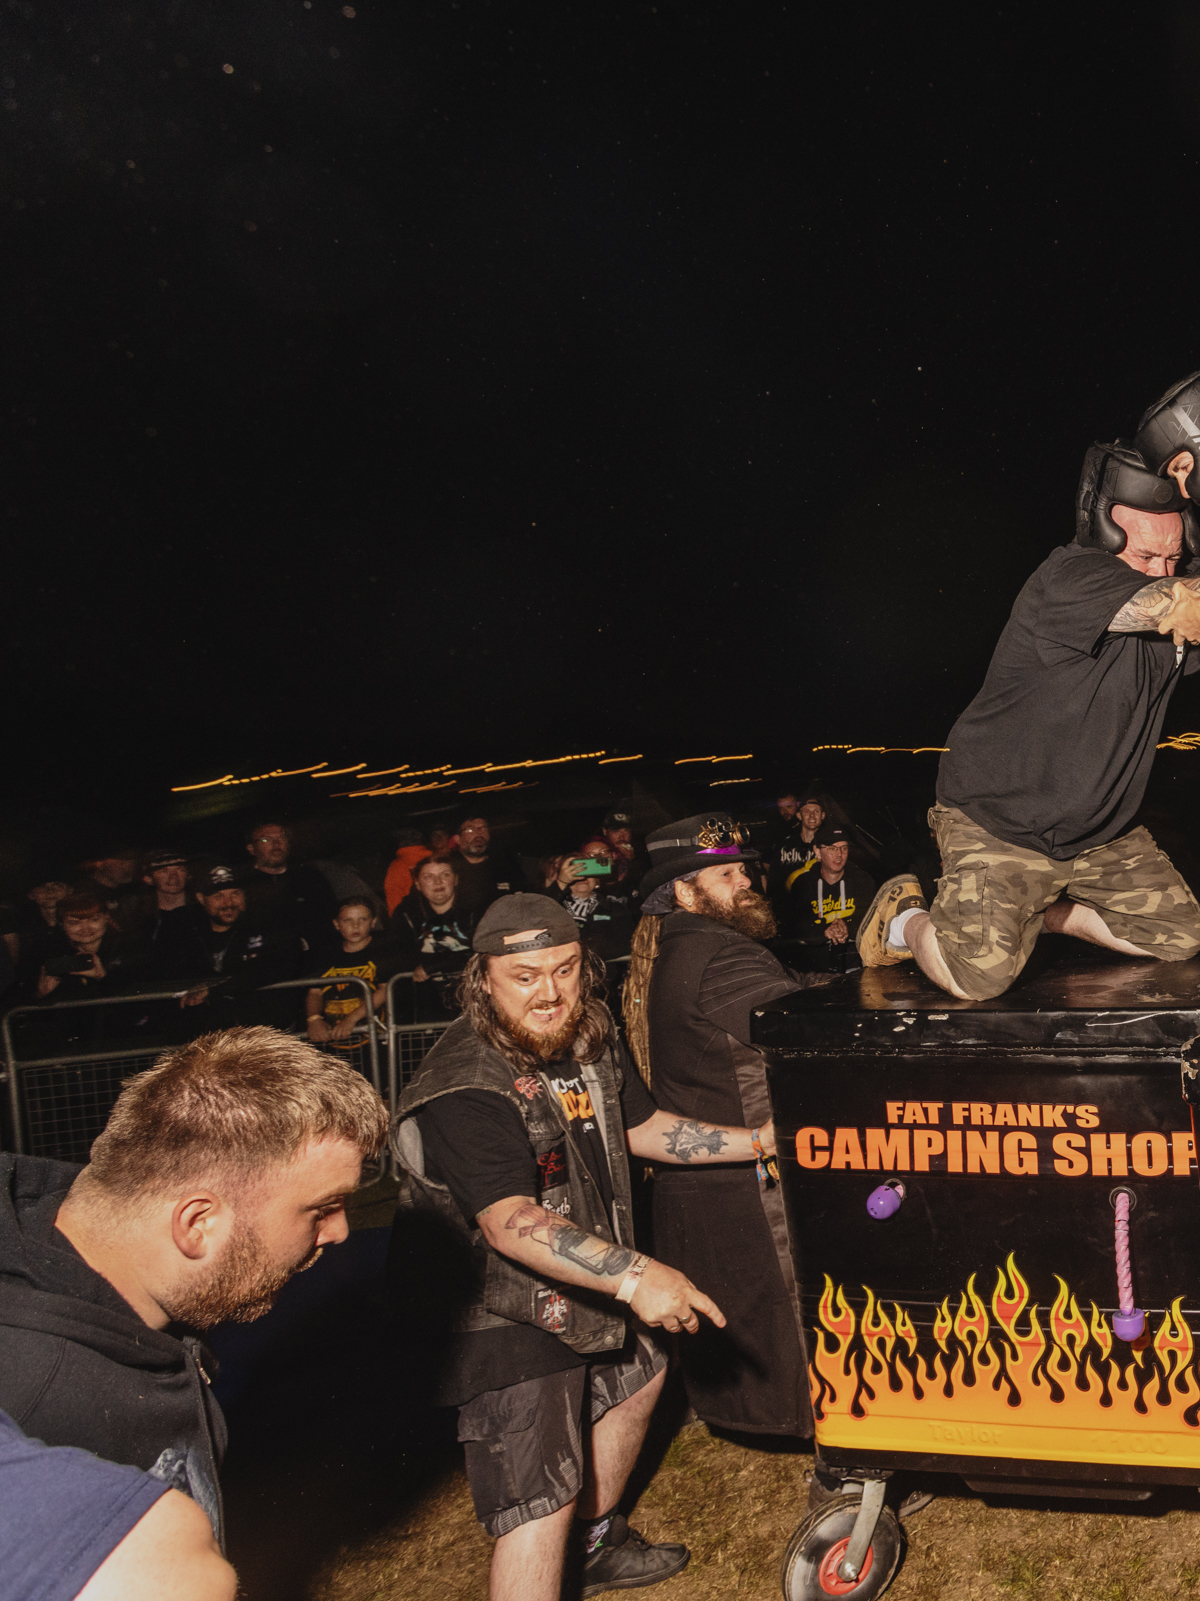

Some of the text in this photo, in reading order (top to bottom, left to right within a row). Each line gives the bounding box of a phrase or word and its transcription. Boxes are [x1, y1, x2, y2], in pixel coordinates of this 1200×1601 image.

[886, 1102, 1100, 1128] FAT FRANK'S
[795, 1127, 1198, 1176] CAMPING SHOP
